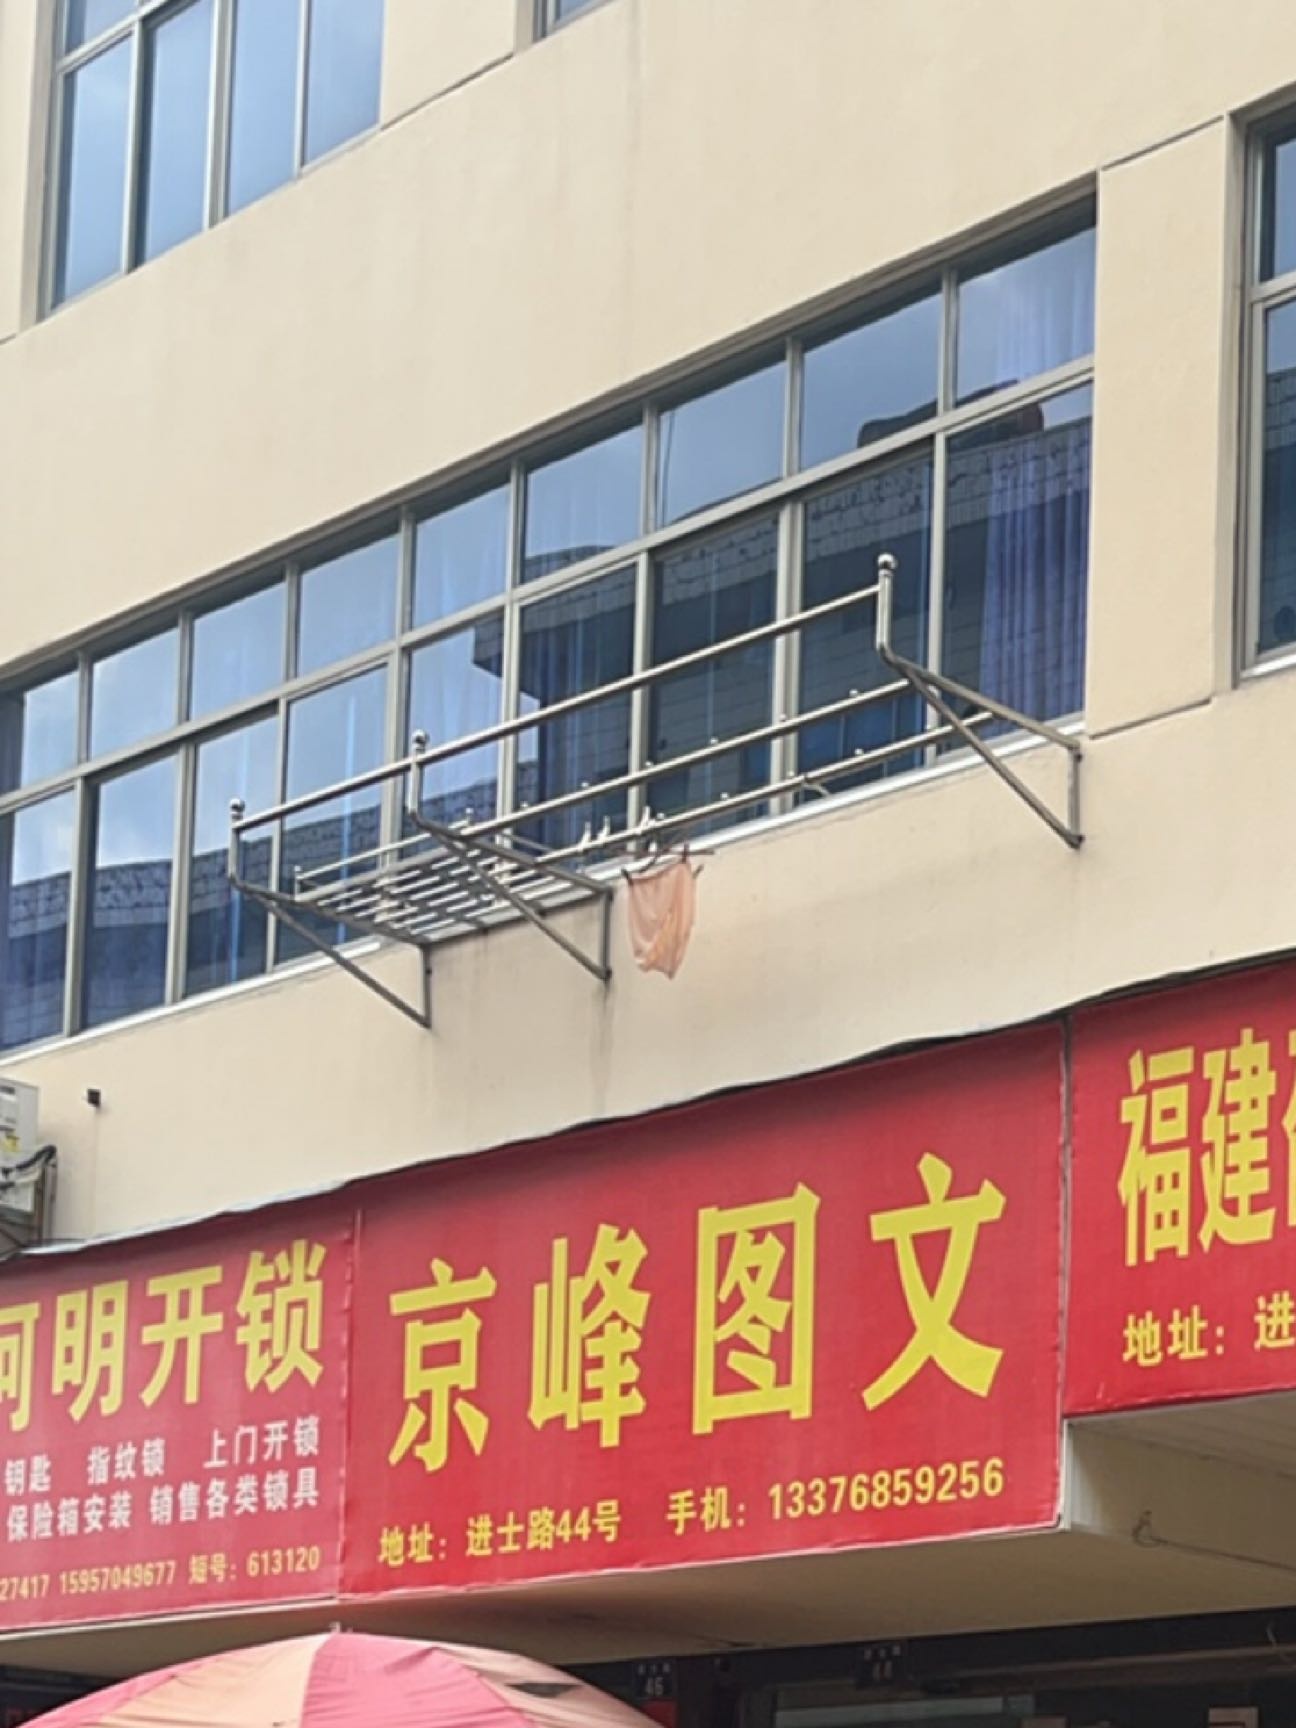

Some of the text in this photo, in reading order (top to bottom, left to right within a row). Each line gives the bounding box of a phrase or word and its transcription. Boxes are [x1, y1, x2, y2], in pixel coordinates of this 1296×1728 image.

[388, 1152, 1005, 1472] 京峰图文
[86, 1437, 166, 1487] 指纹锁
[203, 1416, 320, 1470] 上门开锁
[6, 1467, 319, 1542] 保险箱安装 销售各类锁具
[59, 1559, 177, 1596] 15957049677
